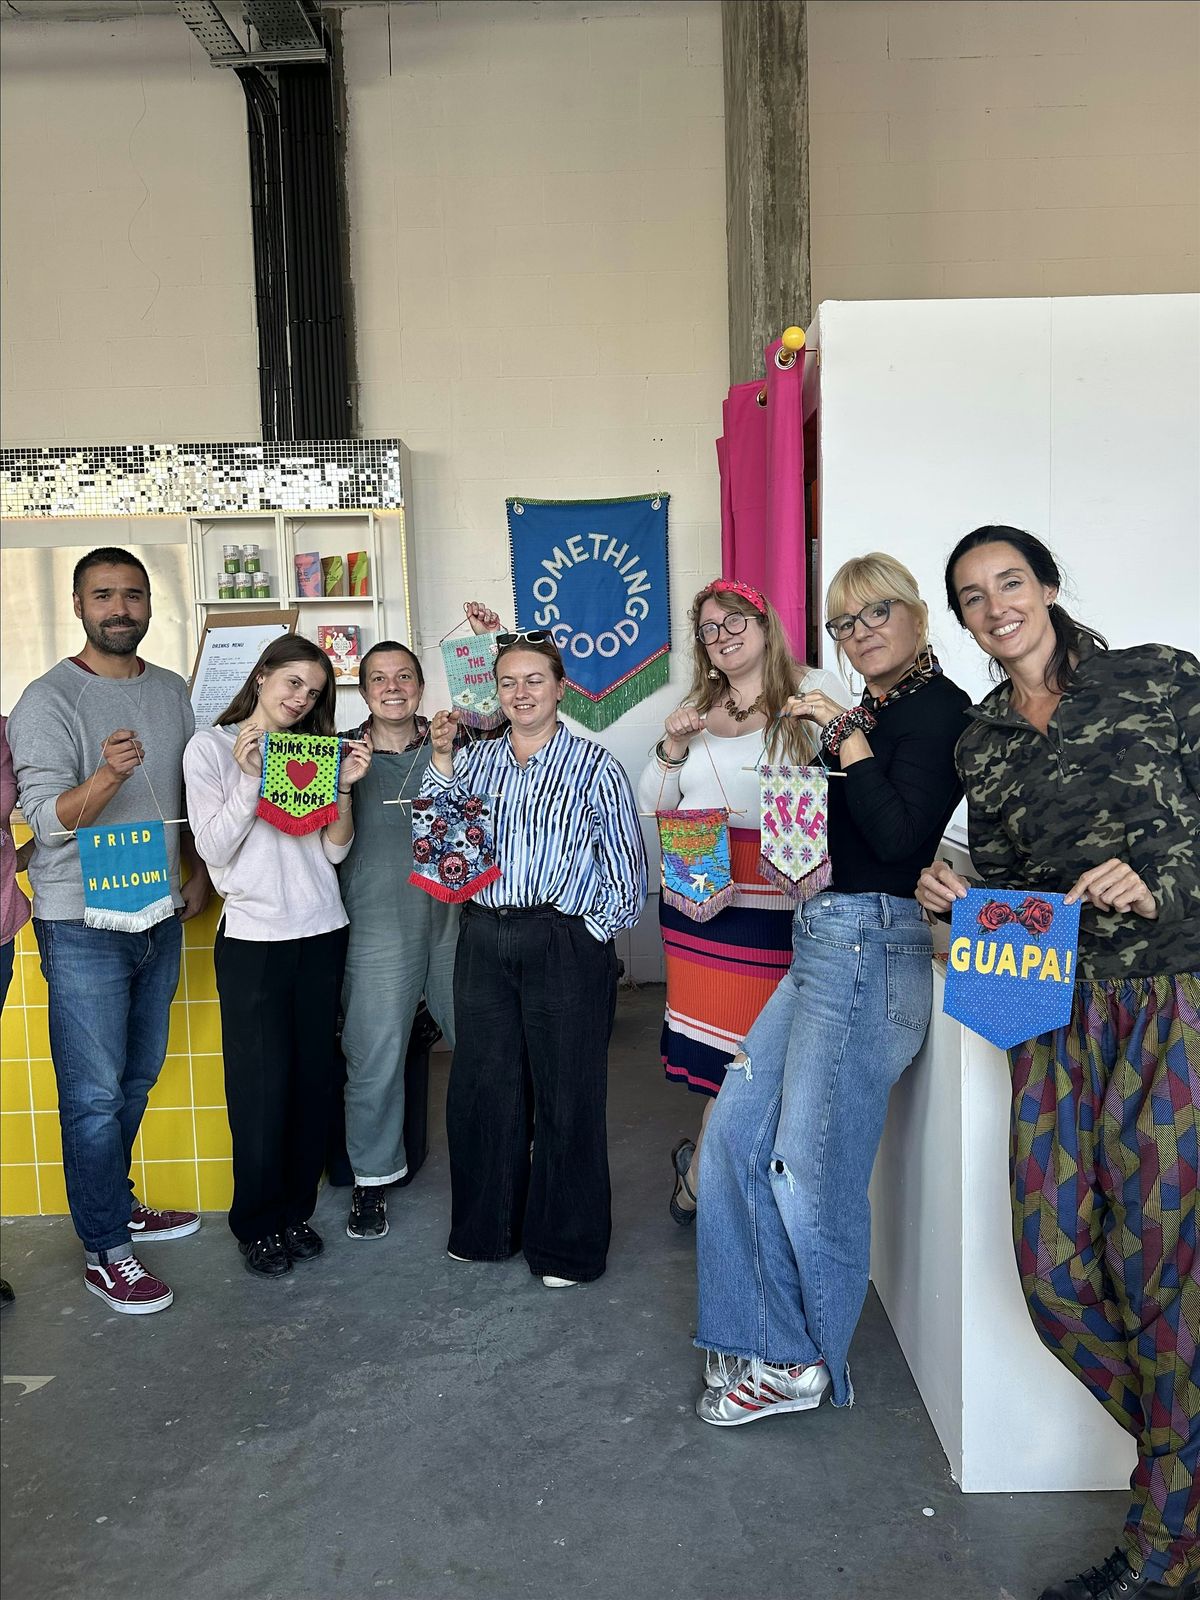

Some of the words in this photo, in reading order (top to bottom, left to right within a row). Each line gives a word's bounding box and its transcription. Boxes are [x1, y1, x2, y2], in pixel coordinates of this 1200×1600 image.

[533, 532, 652, 627] SOMETHING
[550, 618, 640, 659] GOOD
[456, 645, 470, 658] DO
[467, 656, 486, 669] THE
[463, 671, 494, 685] HUSTL
[269, 741, 303, 755] THINK
[308, 744, 335, 757] LESS
[271, 790, 288, 804] DO
[294, 791, 326, 806] MORE
[763, 795, 826, 841] FREE
[93, 829, 151, 848] FRIED
[88, 868, 167, 891] HALLOUMI
[950, 936, 1073, 984] GUAPA!
